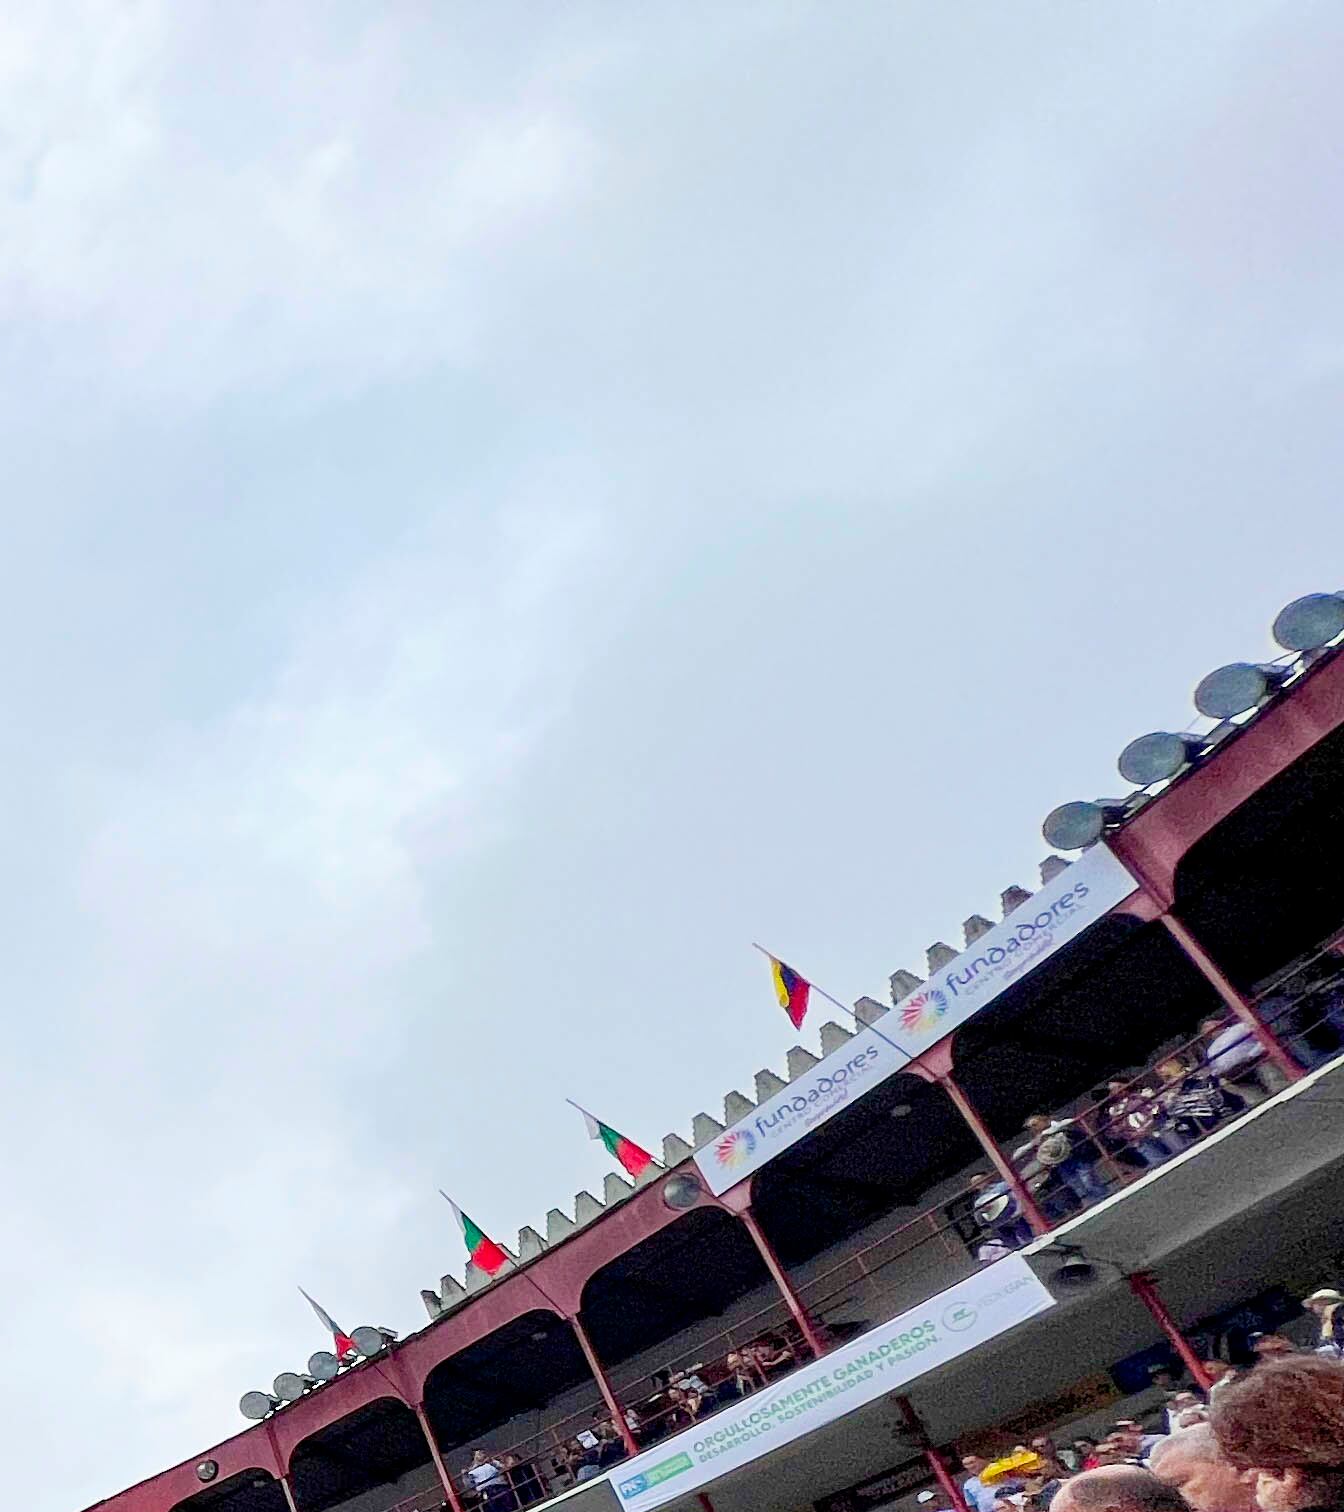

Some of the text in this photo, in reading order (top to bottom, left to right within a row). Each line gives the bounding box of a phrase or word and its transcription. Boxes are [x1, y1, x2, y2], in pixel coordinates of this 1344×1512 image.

[946, 882, 1089, 996] fundadores
[755, 1045, 879, 1137] fundadores
[693, 1319, 937, 1453] ORGULLOSAMENTE GANADEROS
